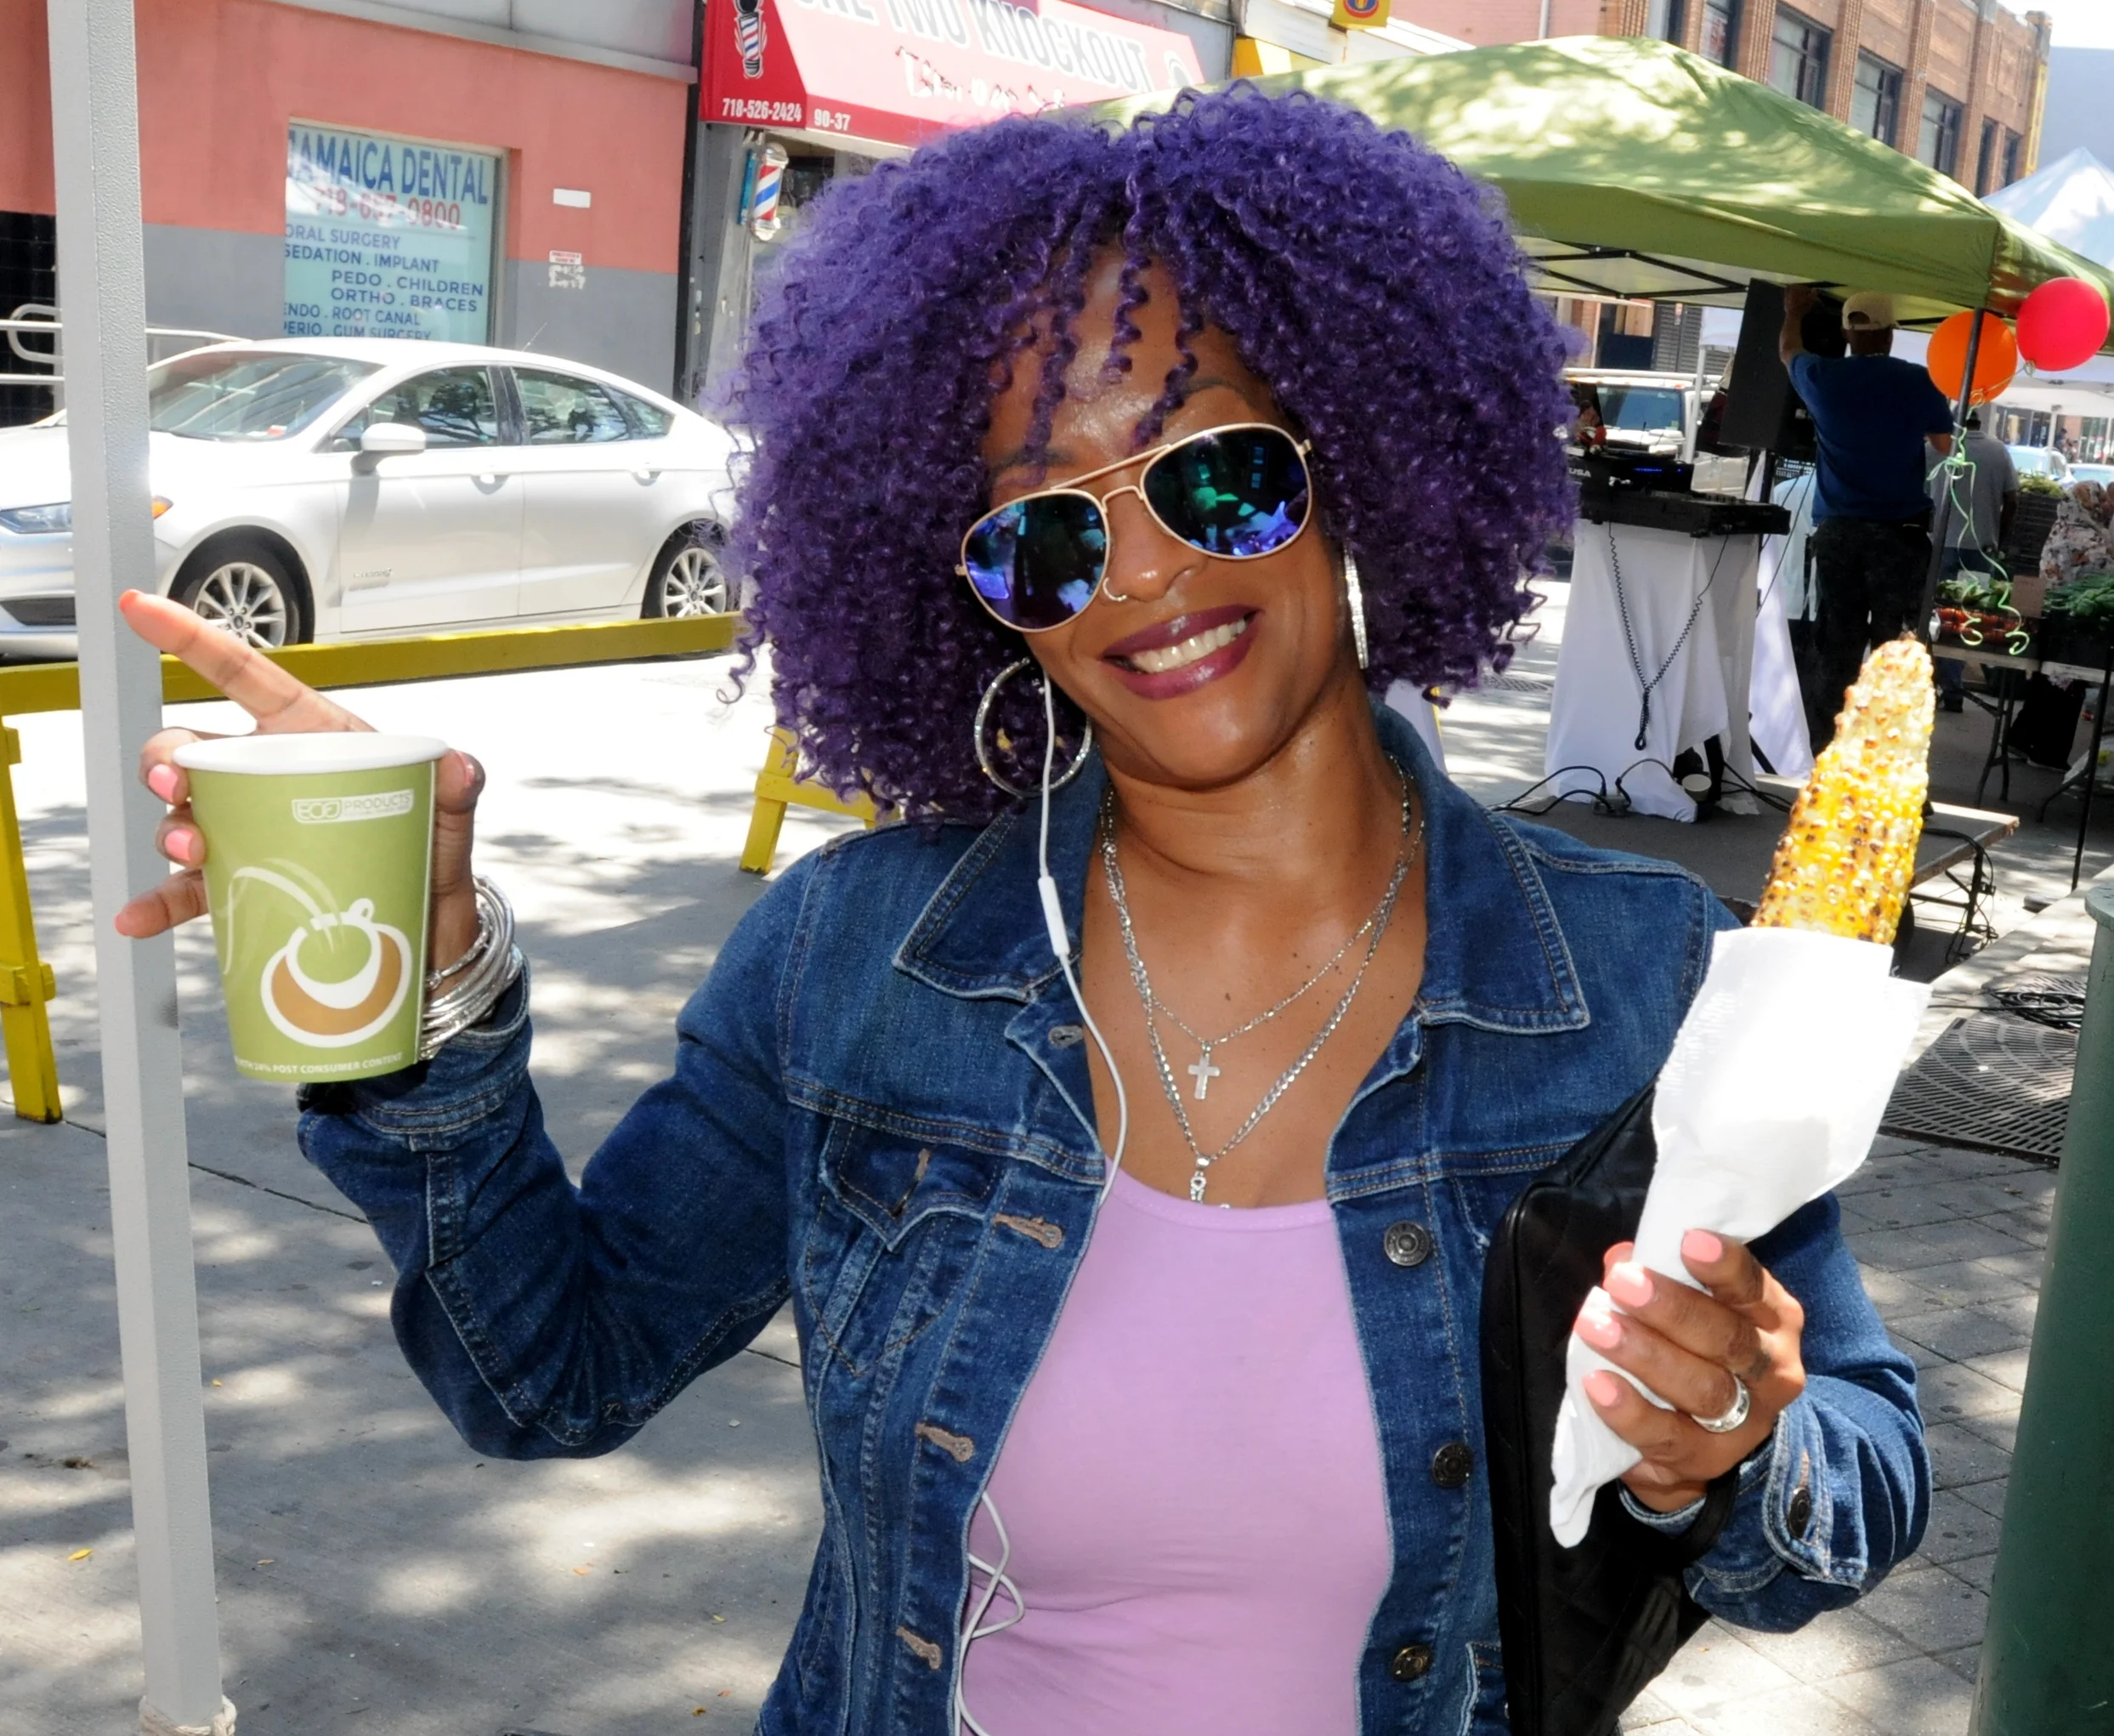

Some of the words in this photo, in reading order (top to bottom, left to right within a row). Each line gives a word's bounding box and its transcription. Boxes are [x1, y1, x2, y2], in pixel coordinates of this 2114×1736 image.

[969, 0, 1154, 94] KNOCKOUT
[723, 98, 802, 122] 718-526-2424
[813, 108, 851, 131] 90-37
[401, 146, 488, 205] DENTAL
[285, 224, 325, 241] ORAL
[330, 229, 400, 250] SURGERY
[285, 242, 361, 265] SEDATION
[374, 253, 439, 273] IMPLANT
[332, 269, 382, 286] PEDO
[396, 276, 484, 296] CHILDREN
[331, 287, 395, 305] ORTHO
[410, 294, 477, 312] BRACES
[332, 306, 370, 321] ROOT
[375, 309, 420, 326] CANAL
[333, 325, 365, 338] GUM
[370, 326, 431, 339] SURGERY
[1569, 468, 1591, 478] USA
[344, 793, 411, 810] PRODUCTS
[272, 1064, 298, 1074] POST
[300, 1061, 360, 1074] CONSUMER
[362, 1052, 402, 1069] CONTENT
